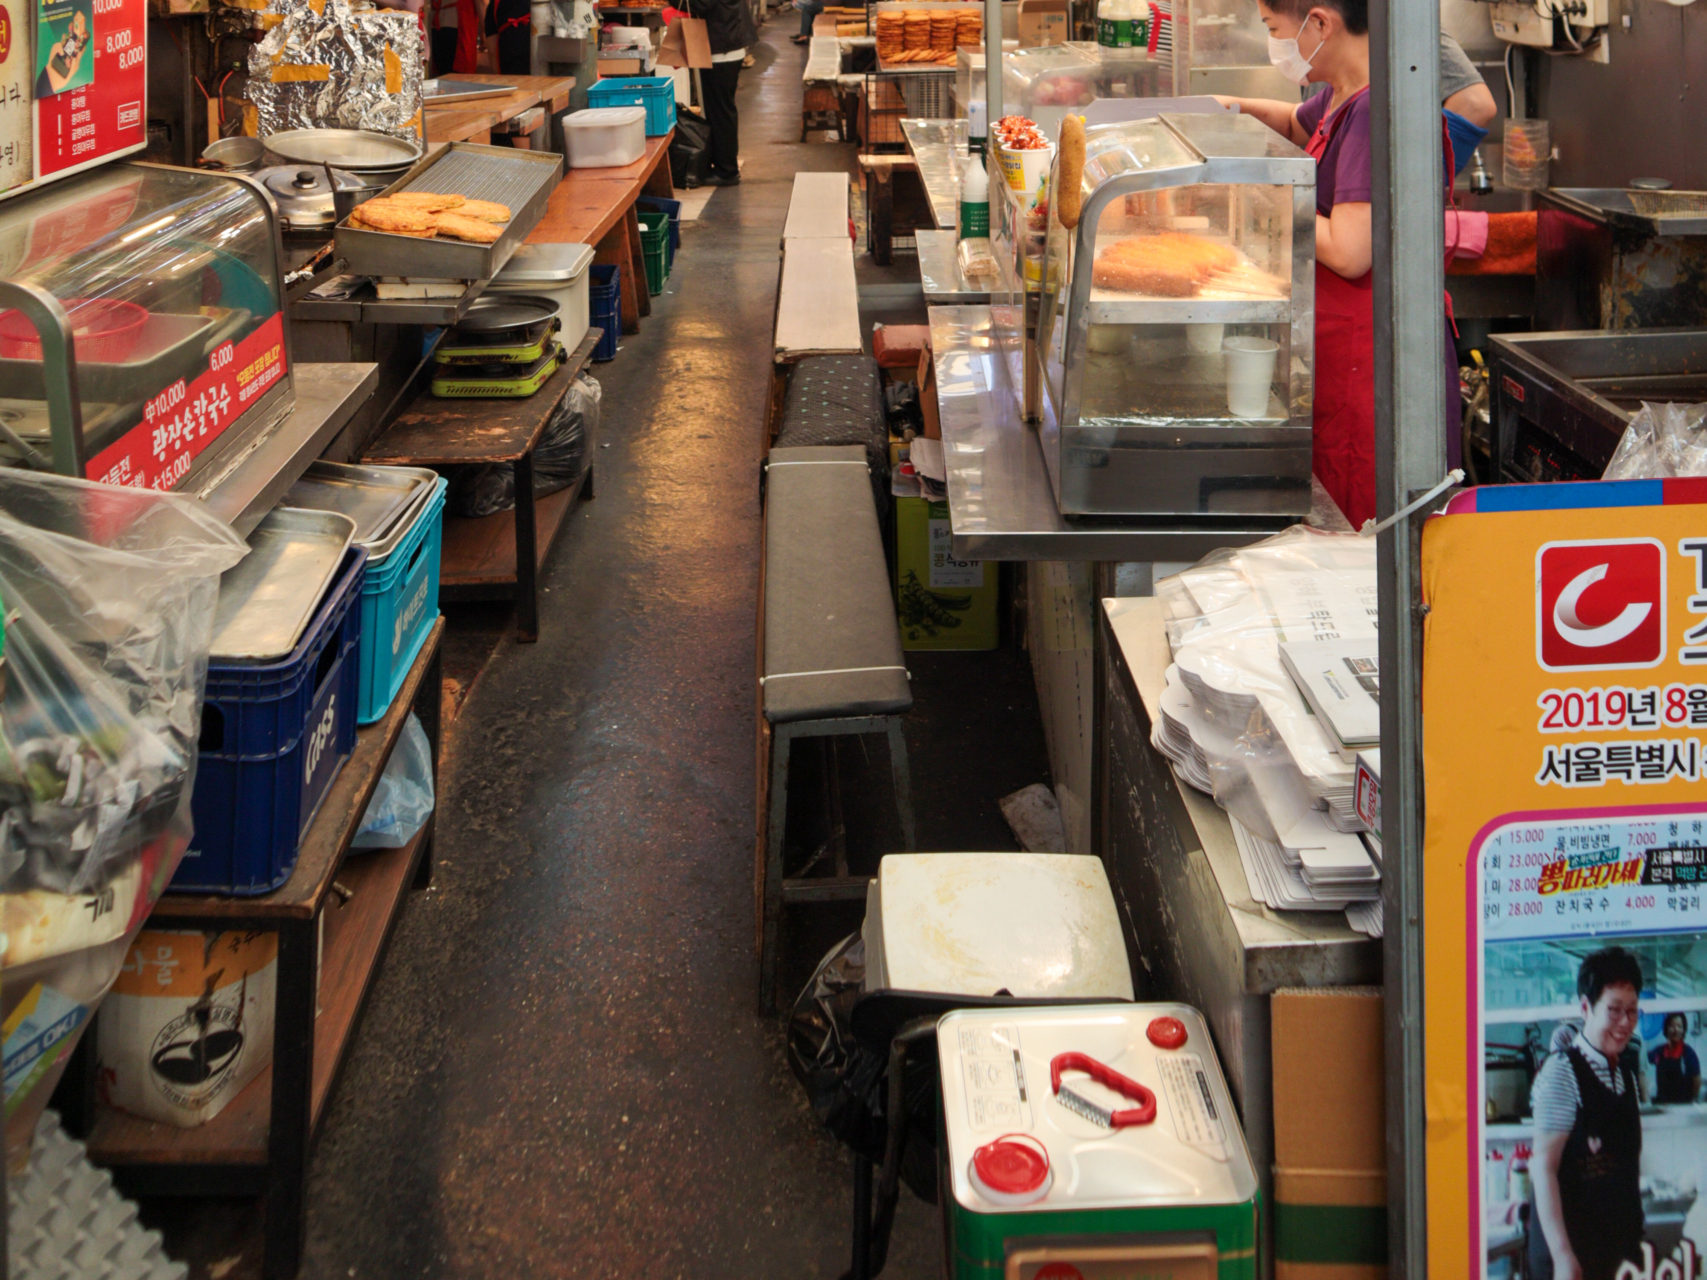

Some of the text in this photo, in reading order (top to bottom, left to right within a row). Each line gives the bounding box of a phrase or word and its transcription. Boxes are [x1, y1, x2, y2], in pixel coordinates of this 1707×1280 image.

[106, 30, 131, 54] 8,000
[119, 45, 144, 69] 8,000
[210, 343, 233, 371] 6,000
[152, 382, 232, 462] 광장손칼국수
[1542, 690, 1656, 729] 2019년
[1541, 742, 1696, 784] 서울특별시
[1509, 829, 1544, 844] 15.000
[1627, 832, 1657, 847] 7.000
[1508, 853, 1544, 869] 23.000
[1508, 878, 1541, 893] 28.00
[1538, 857, 1646, 896] 뽕따러가세
[1508, 901, 1543, 917] 28.000
[1556, 898, 1610, 915] 잔치국수
[1625, 895, 1655, 909] 4.000
[1667, 897, 1700, 912] 막걸리
